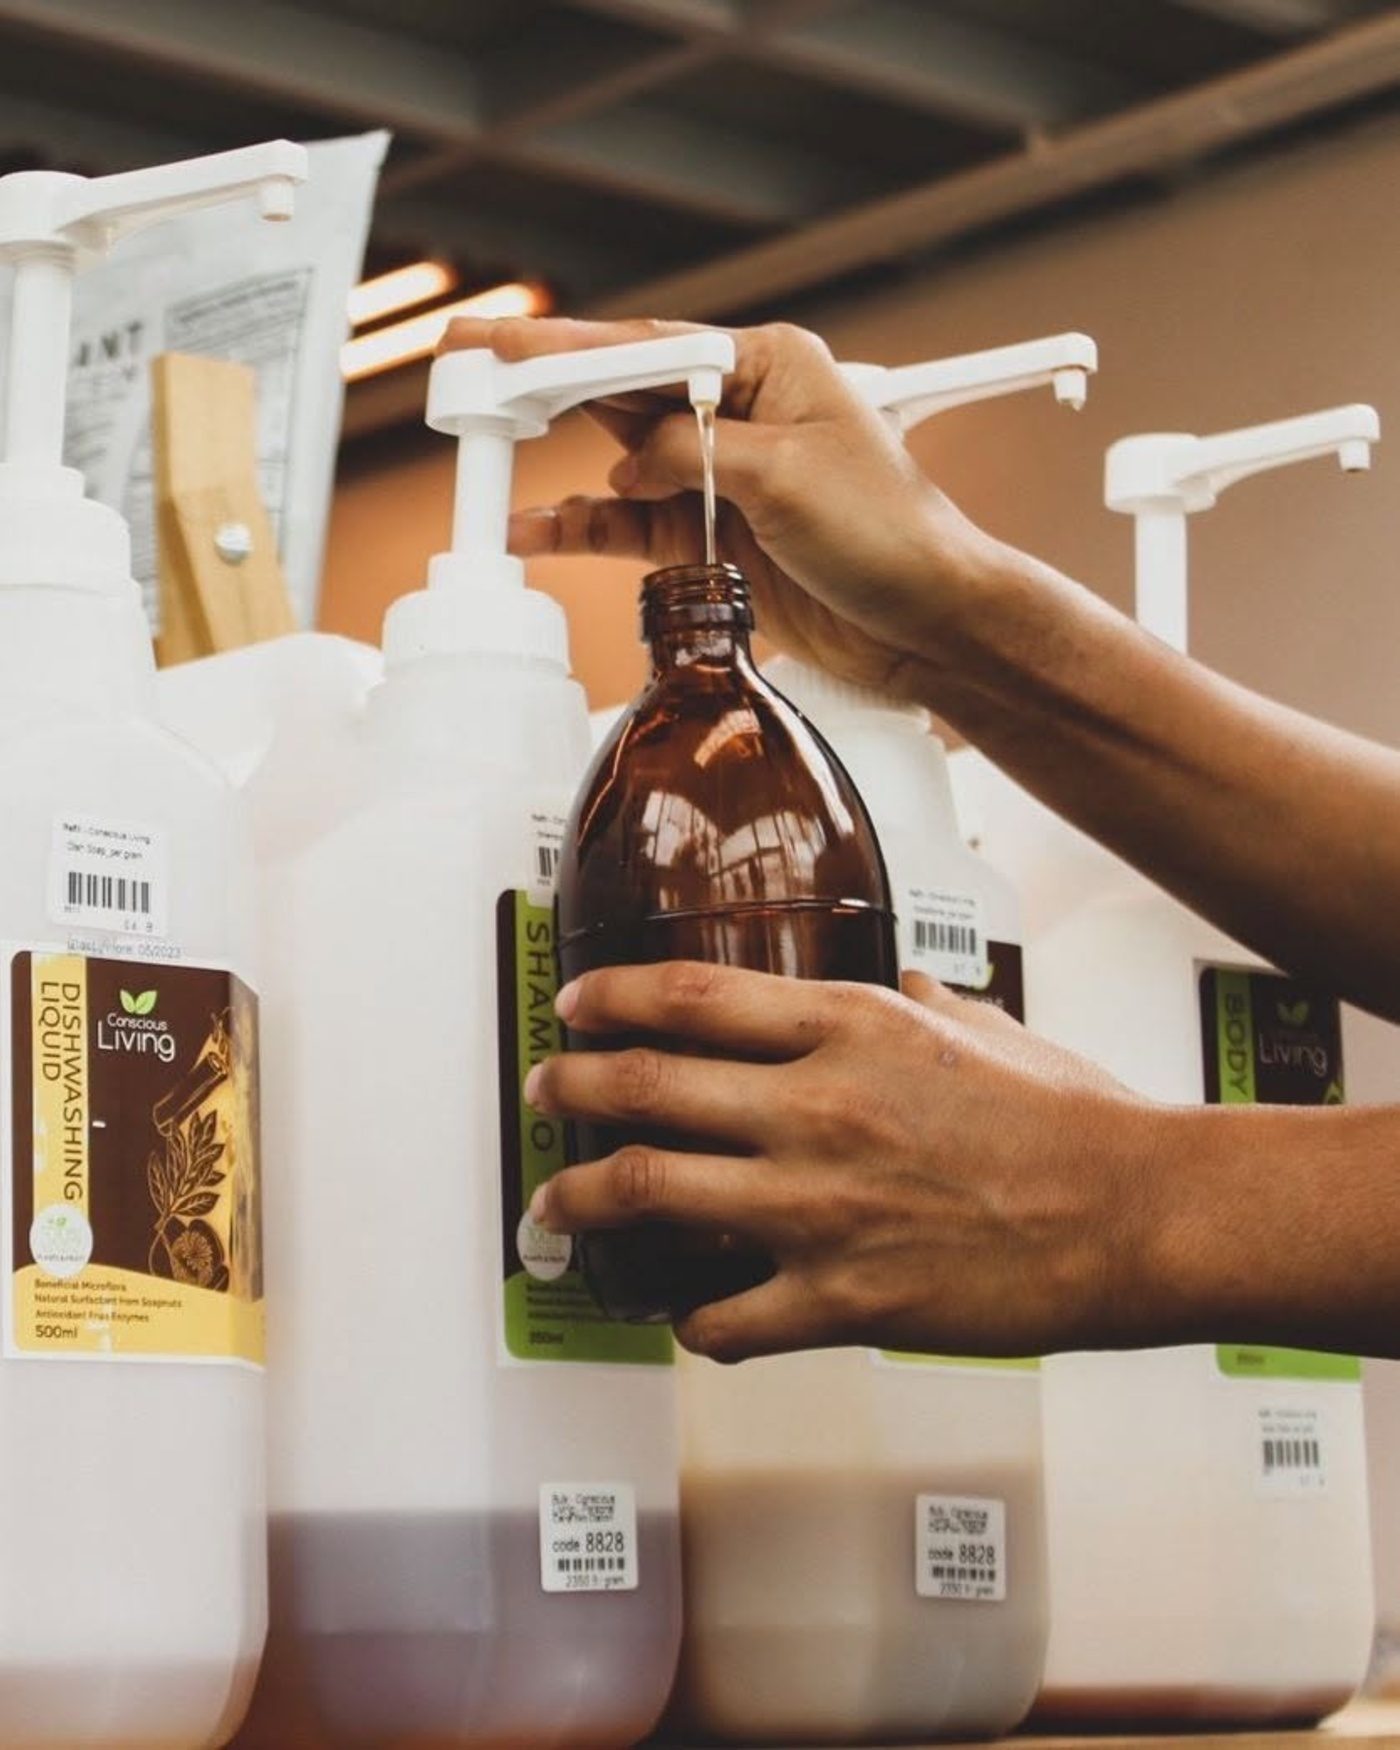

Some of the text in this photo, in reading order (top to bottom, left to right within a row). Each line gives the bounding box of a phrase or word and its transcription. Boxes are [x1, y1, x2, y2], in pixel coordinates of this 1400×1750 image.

[38, 981, 62, 1082] LIQUID
[97, 1020, 175, 1062] Living
[107, 1012, 168, 1031] Conscious
[527, 921, 555, 1153] SHAMO
[1225, 992, 1248, 1096] BODY
[62, 983, 83, 1201] DISHWASHING
[34, 1293, 68, 1303] Natural
[35, 1324, 78, 1339] 500ml
[552, 1532, 624, 1553] code 8828
